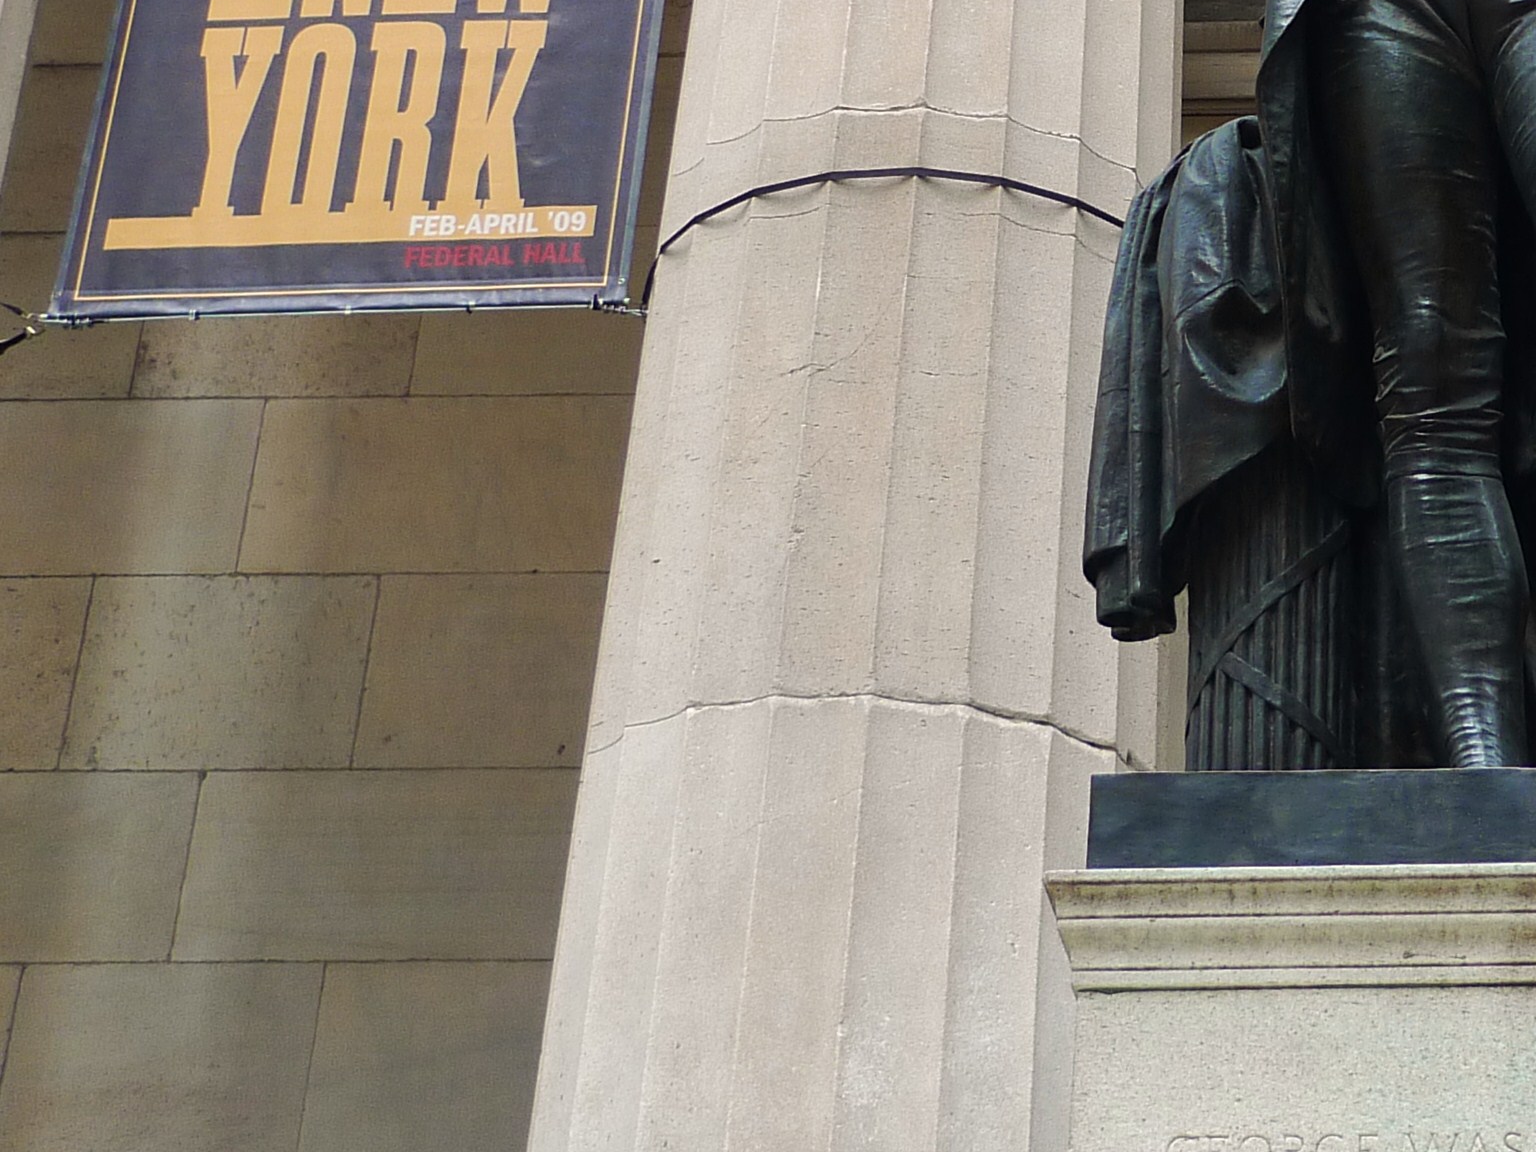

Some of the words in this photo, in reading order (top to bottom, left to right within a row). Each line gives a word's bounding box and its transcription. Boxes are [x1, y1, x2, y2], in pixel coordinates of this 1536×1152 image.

[192, 20, 548, 216] YORK
[408, 212, 539, 237] FEB-APRIL
[548, 210, 587, 233] '09
[404, 244, 514, 269] FEDERAL
[522, 242, 586, 265] HALL
